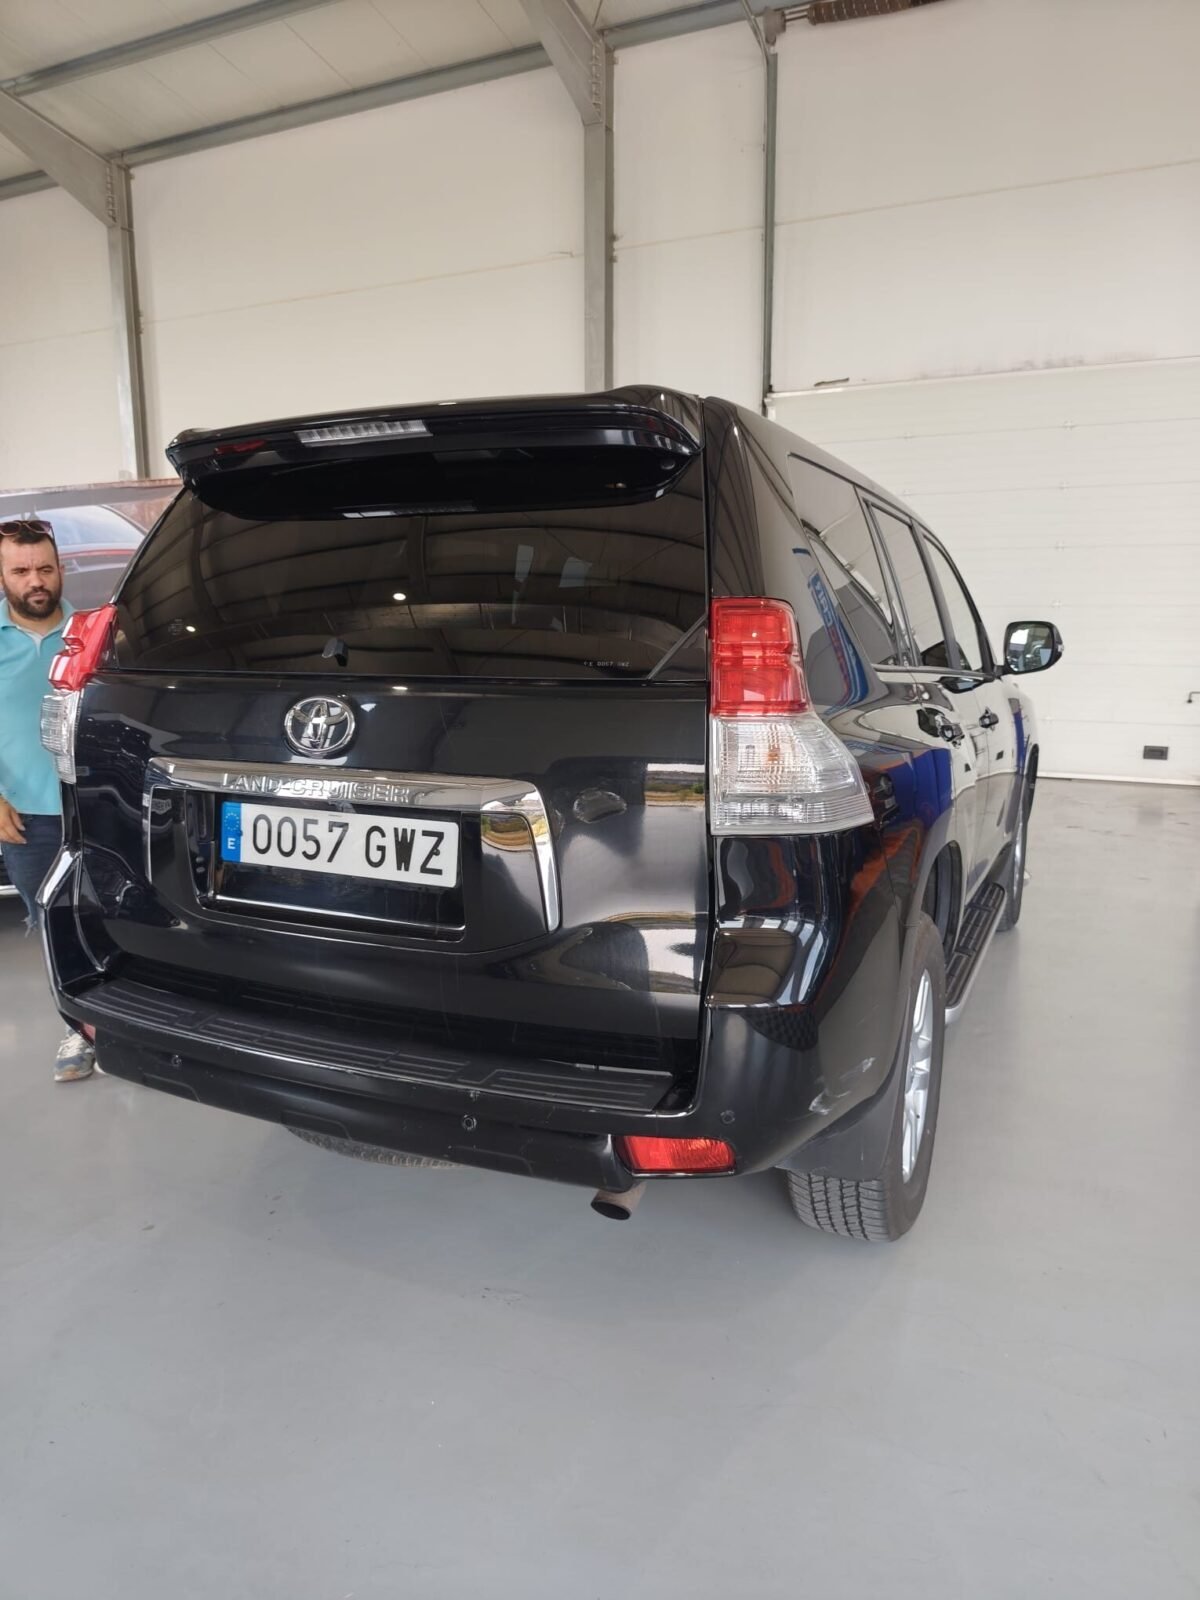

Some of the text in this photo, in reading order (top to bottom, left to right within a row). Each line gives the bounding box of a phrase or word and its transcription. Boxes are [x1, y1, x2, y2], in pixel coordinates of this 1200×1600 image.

[221, 772, 410, 803] LAND CRUISER
[227, 837, 236, 850] E
[252, 813, 445, 876] 0057 GWZ
